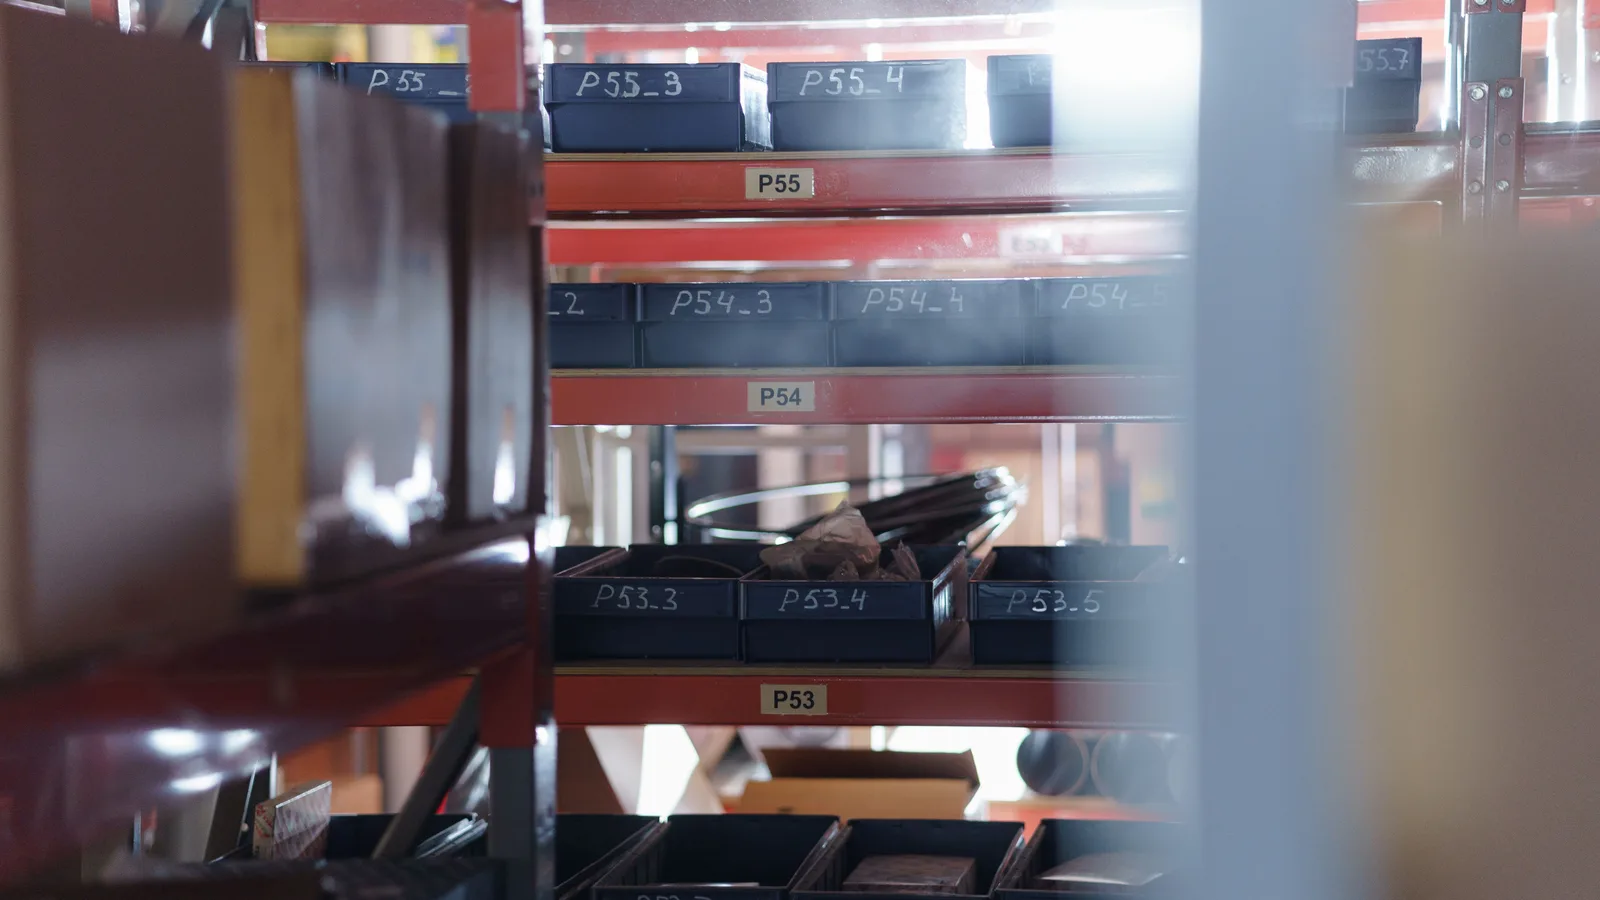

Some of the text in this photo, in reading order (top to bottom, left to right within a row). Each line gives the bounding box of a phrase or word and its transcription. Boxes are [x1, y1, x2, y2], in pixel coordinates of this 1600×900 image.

[1356, 47, 1409, 72] 55_7
[576, 70, 683, 98] P55_3
[799, 66, 904, 96] P55_4
[758, 174, 801, 194] P55
[670, 289, 773, 315] P54_3
[861, 287, 964, 313] P54_4
[1061, 283, 1169, 310] P54_5
[760, 387, 802, 406] P54
[590, 584, 679, 611] P53_3
[778, 588, 868, 612] P53_4
[1007, 589, 1103, 613] P53_5
[773, 690, 815, 709] P53
